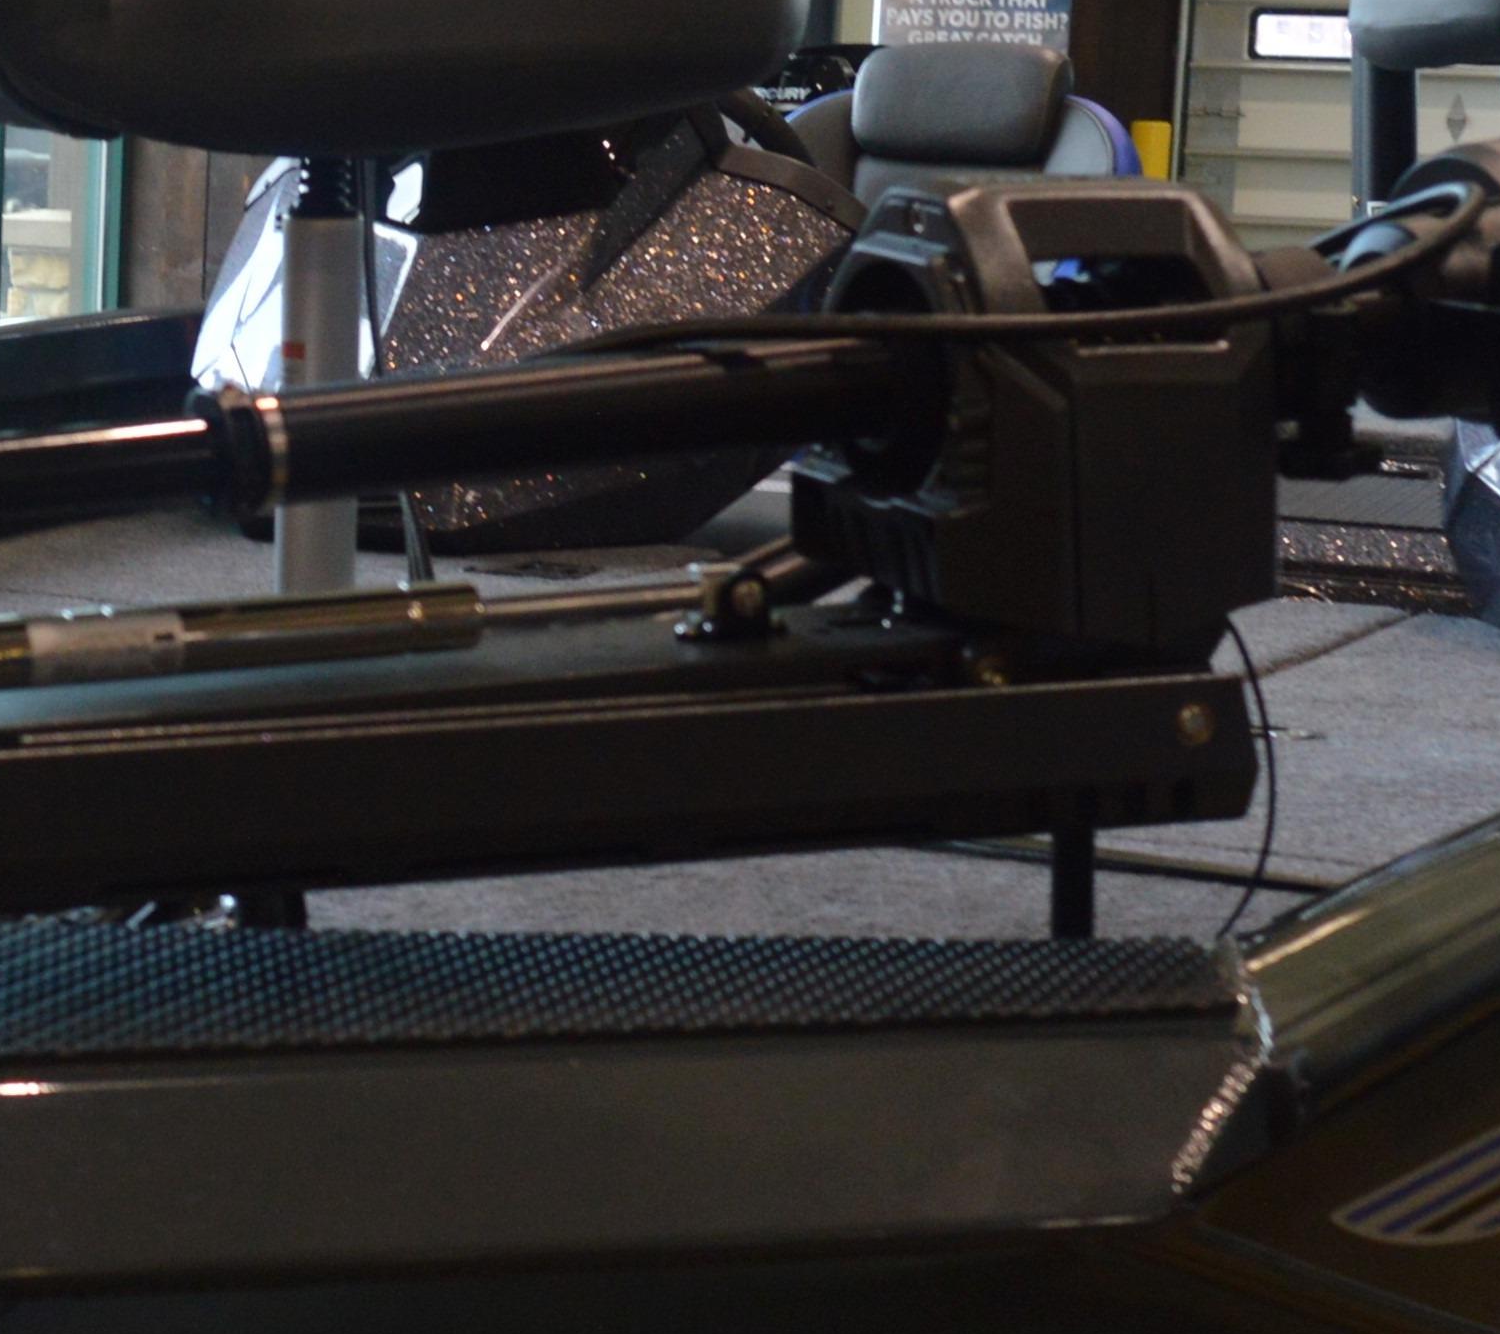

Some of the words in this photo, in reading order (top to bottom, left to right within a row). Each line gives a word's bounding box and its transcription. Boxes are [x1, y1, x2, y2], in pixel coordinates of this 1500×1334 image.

[887, 7, 934, 27] PAYS
[936, 9, 981, 28] YOU
[982, 10, 1009, 29] TO
[1013, 12, 1069, 32] FISH?
